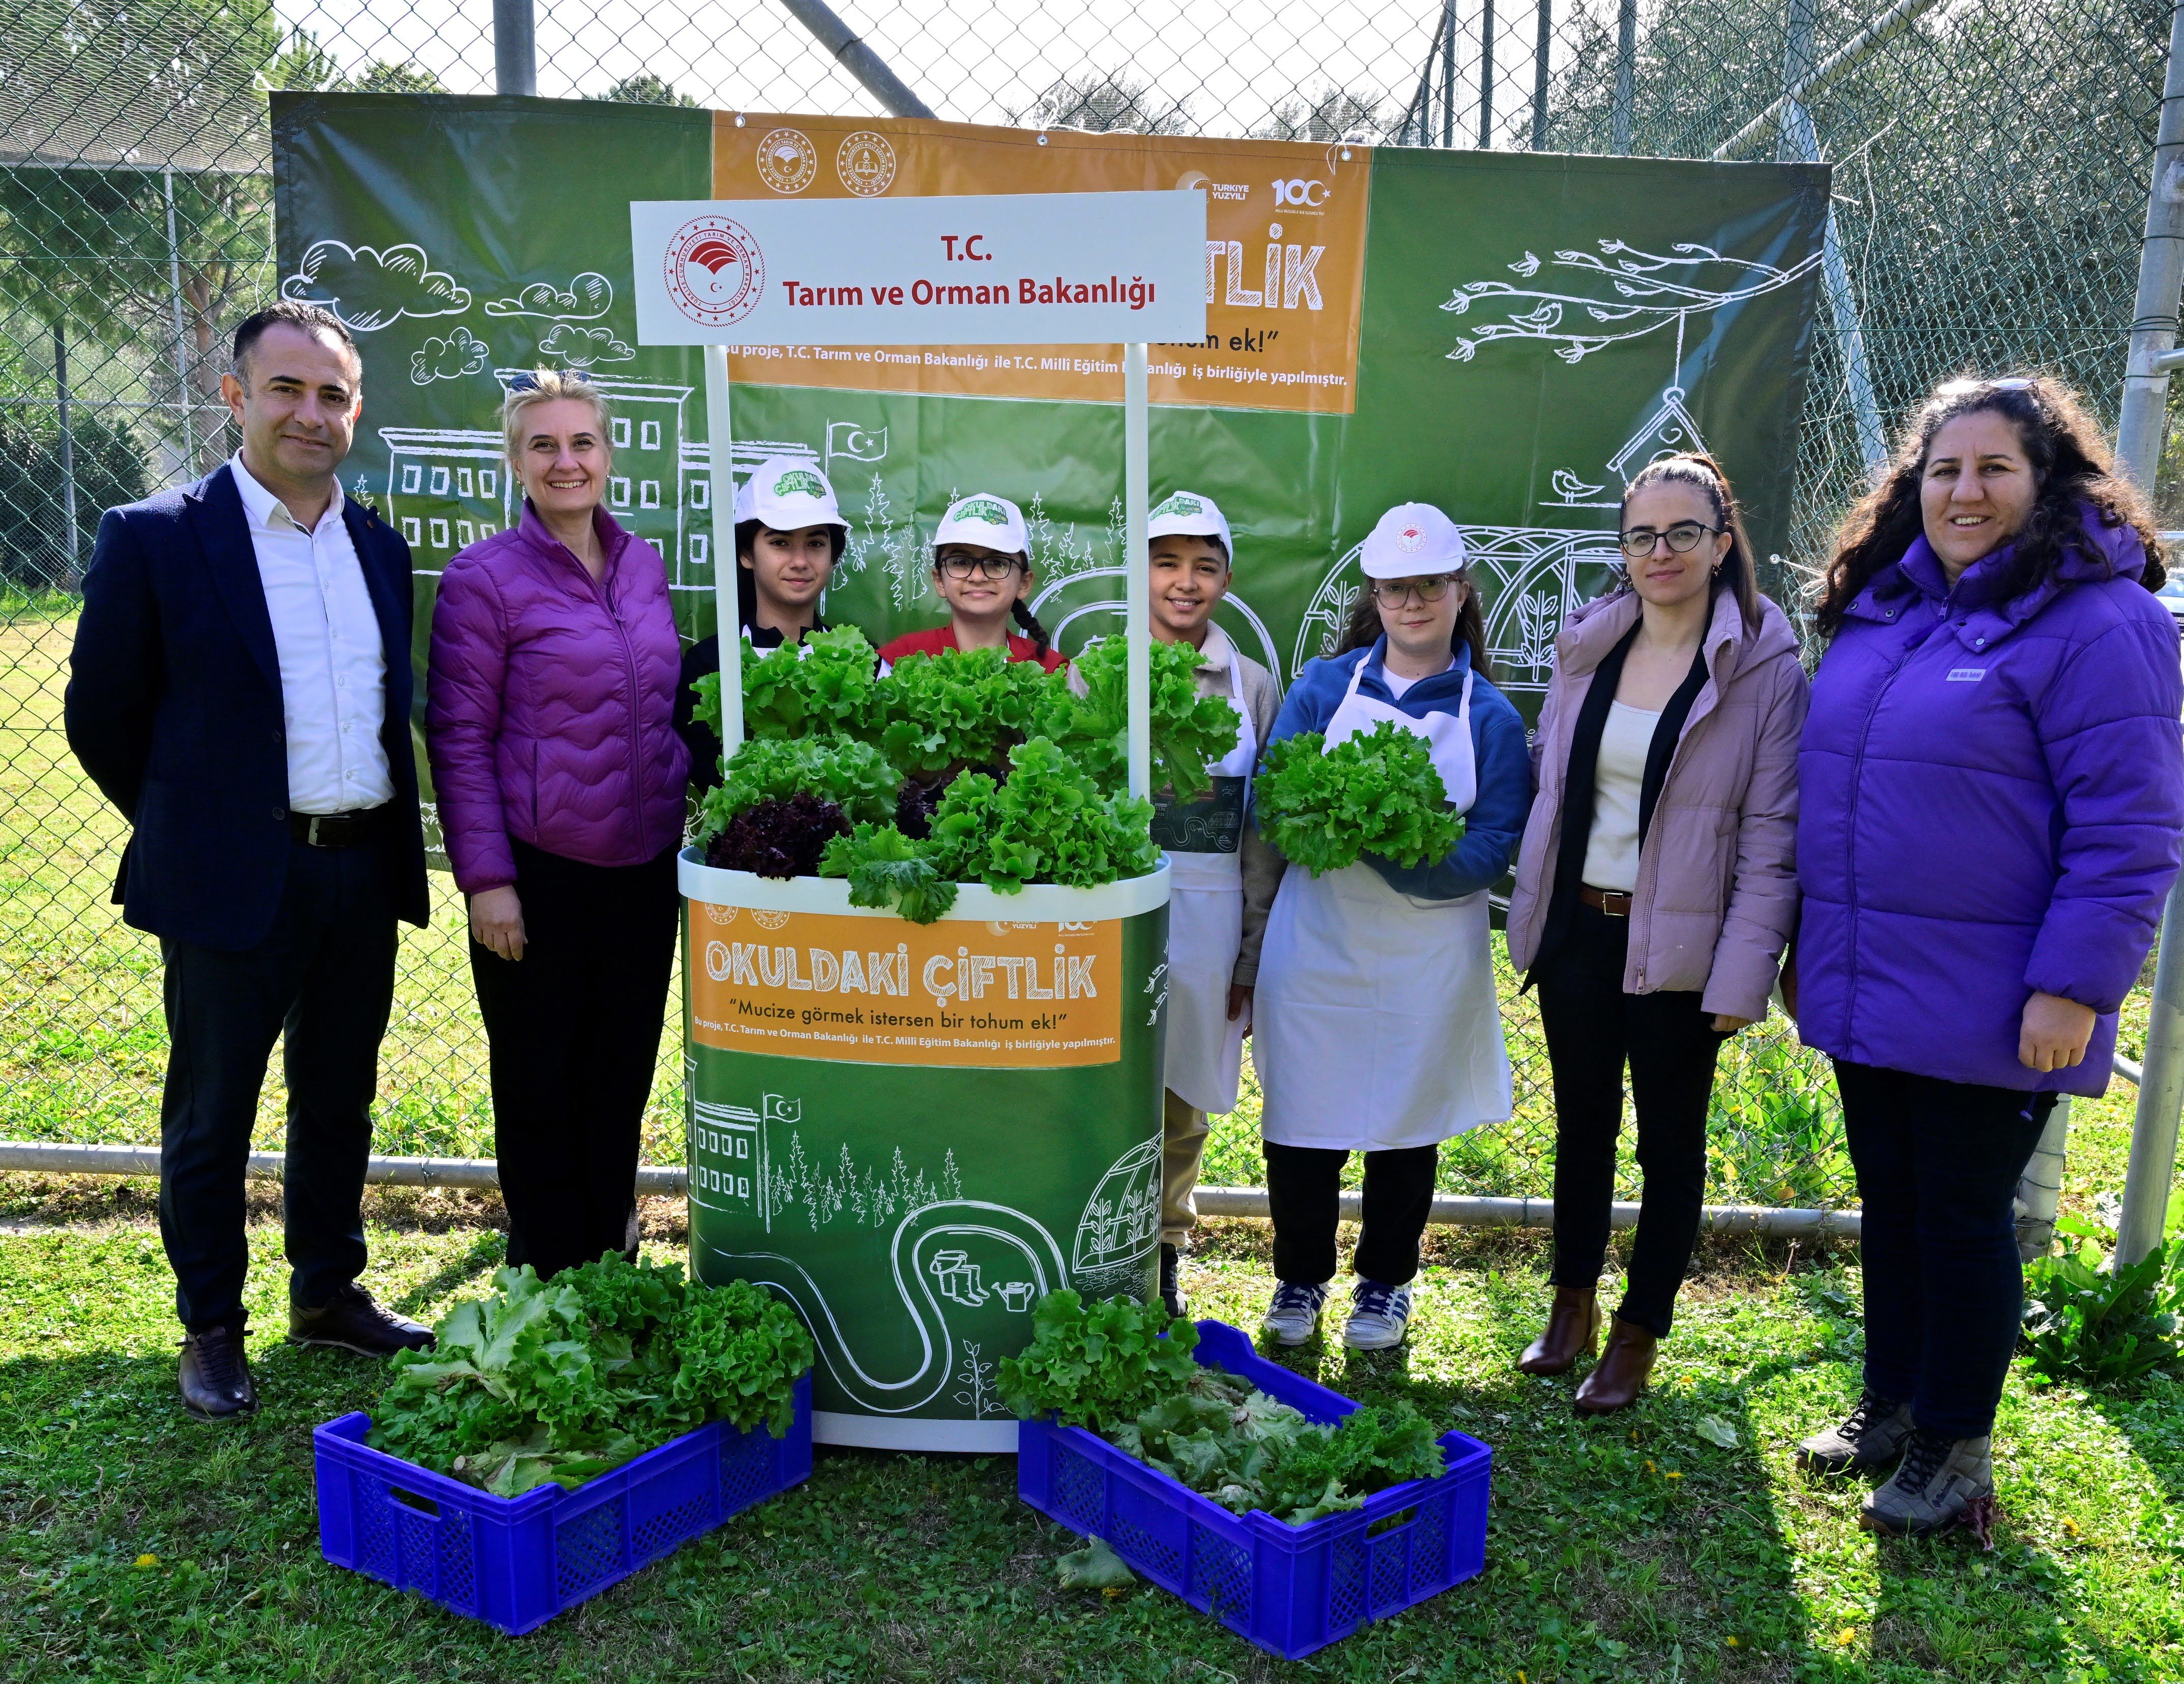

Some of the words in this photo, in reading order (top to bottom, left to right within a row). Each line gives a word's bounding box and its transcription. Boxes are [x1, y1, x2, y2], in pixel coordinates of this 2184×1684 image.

[727, 236, 735, 244] VE
[736, 244, 749, 269] ORMAN
[941, 235, 992, 261] T.C.
[1206, 223, 1326, 311] TLİK
[729, 272, 749, 307] BAKANLIĞI
[782, 281, 863, 306] Tarım
[871, 286, 904, 305] ve
[911, 280, 1010, 305] Orman
[1019, 275, 1156, 311] Bakanlığı
[743, 346, 783, 359] proje,
[786, 346, 810, 359] T.C.
[813, 347, 852, 361] Tarım
[855, 352, 871, 362] ve
[874, 350, 921, 365] Orman
[924, 352, 988, 371] Bakanlığı
[994, 355, 1011, 369] ile
[1014, 356, 1037, 370] T.C.
[1074, 358, 1118, 375] Eğitim
[1193, 364, 1203, 380] iş
[1207, 365, 1267, 383] birliğiyle
[1270, 371, 1347, 387] yapılmıştır.
[706, 940, 909, 996] OKULDAKİ
[923, 943, 1097, 1008] ÇİFTLİK
[694, 1016, 702, 1028] Bu
[703, 1020, 723, 1032] proje,
[724, 1023, 739, 1034] T.C.
[740, 1025, 765, 1036] Tarım
[767, 1028, 778, 1037] ve
[780, 1029, 812, 1040] Orman
[813, 1031, 858, 1045] Bakanlığı
[862, 1035, 874, 1044] ile
[875, 1035, 893, 1045] T.C.
[919, 1037, 951, 1049] Eğitim
[953, 1038, 1000, 1050] Bakanlığı
[1005, 1039, 1013, 1050] iş
[1015, 1039, 1060, 1051] birliğiyle
[1063, 1036, 1115, 1050] yapılmıştır.
[802, 1007, 864, 1025] görmek
[870, 1009, 934, 1027] istersen
[941, 1011, 964, 1028] bir
[970, 1013, 1024, 1029] tohum
